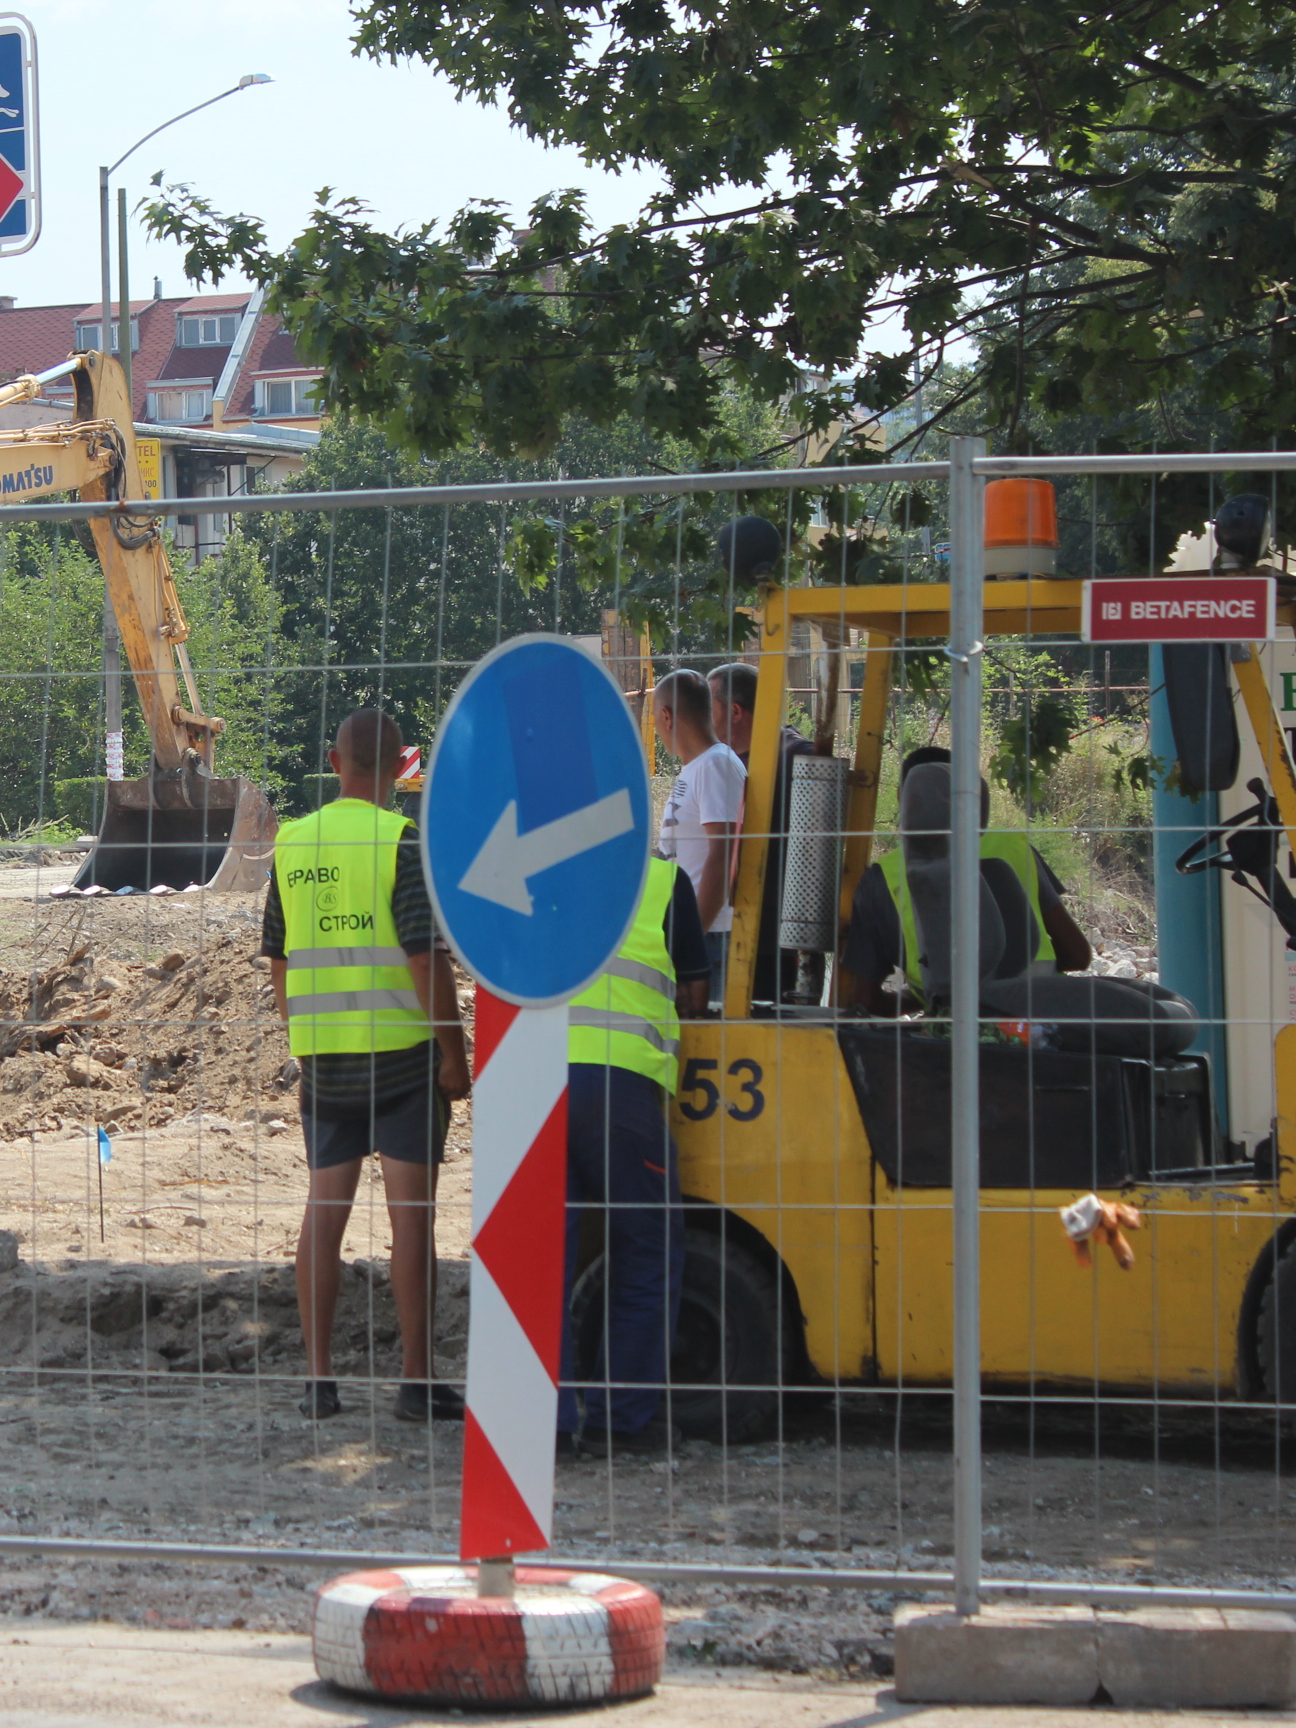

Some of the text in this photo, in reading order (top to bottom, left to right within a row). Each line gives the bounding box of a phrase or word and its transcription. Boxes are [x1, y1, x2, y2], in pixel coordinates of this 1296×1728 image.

[137, 445, 156, 457] TEL
[1130, 600, 1256, 620] BETAFENCE
[319, 911, 374, 932] СТРОЙ
[679, 1058, 765, 1122] 53
